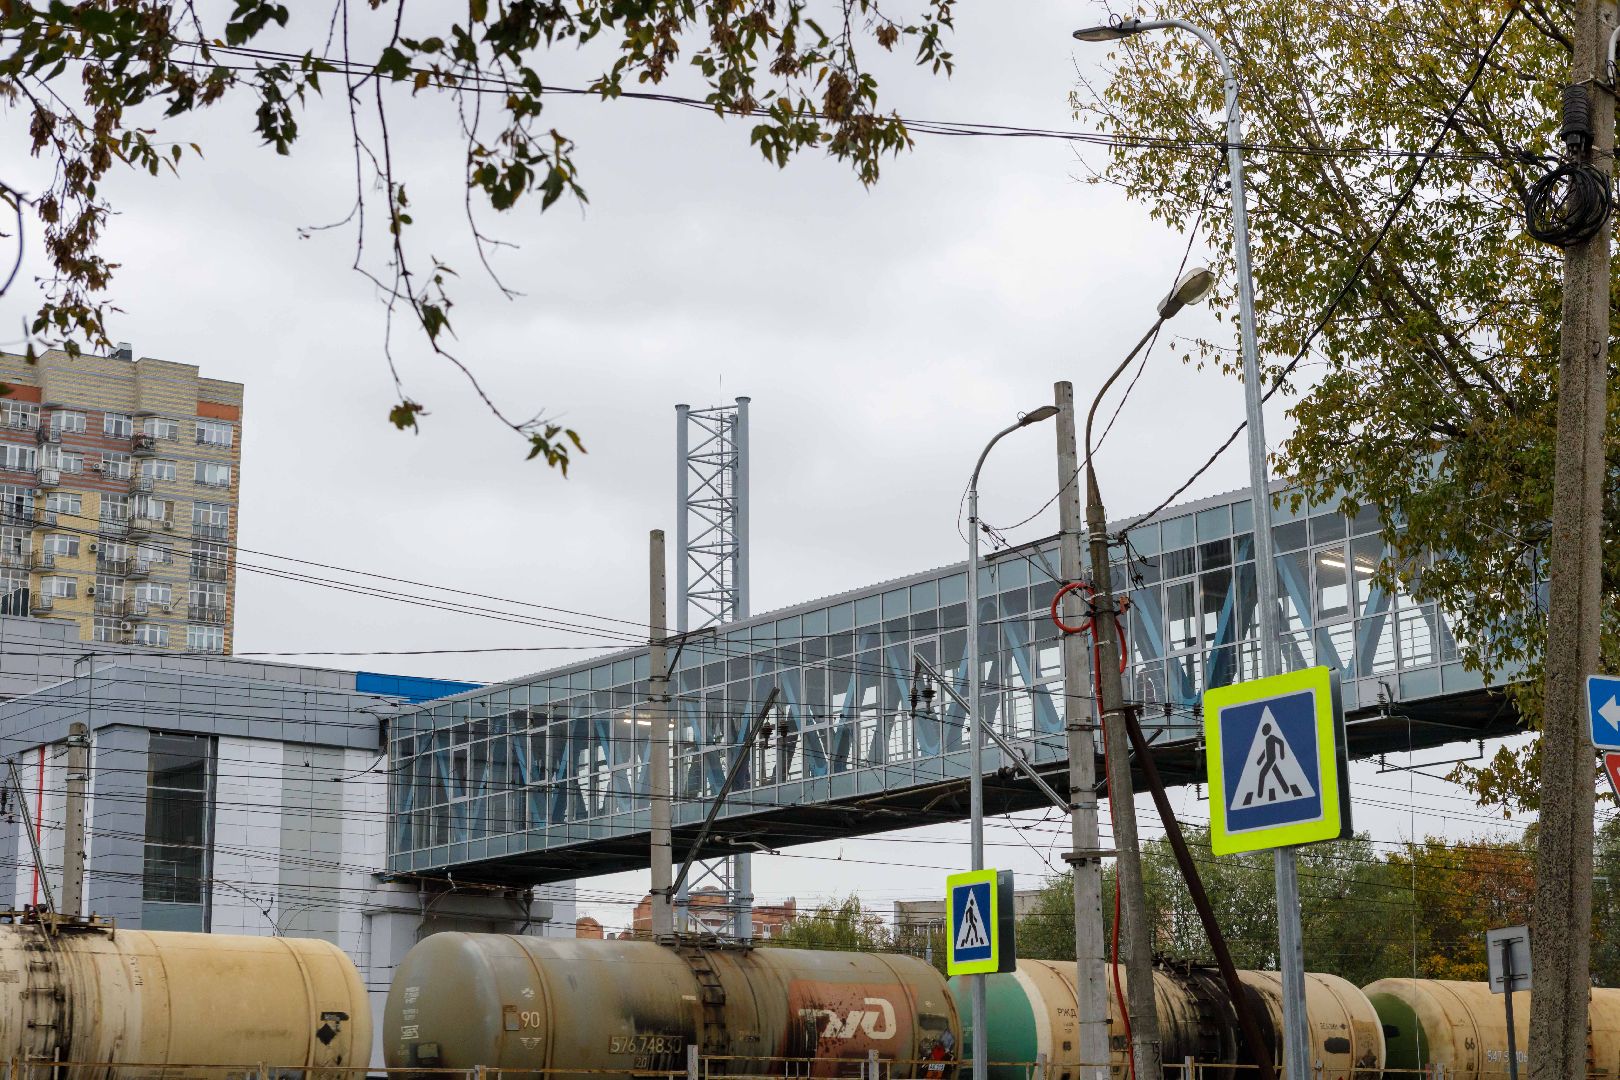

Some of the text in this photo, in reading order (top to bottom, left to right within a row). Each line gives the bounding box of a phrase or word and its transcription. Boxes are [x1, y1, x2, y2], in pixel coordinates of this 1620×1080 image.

[1057, 1007, 1078, 1018] РЖД
[521, 1012, 540, 1028] 90
[1464, 1037, 1476, 1050] 66
